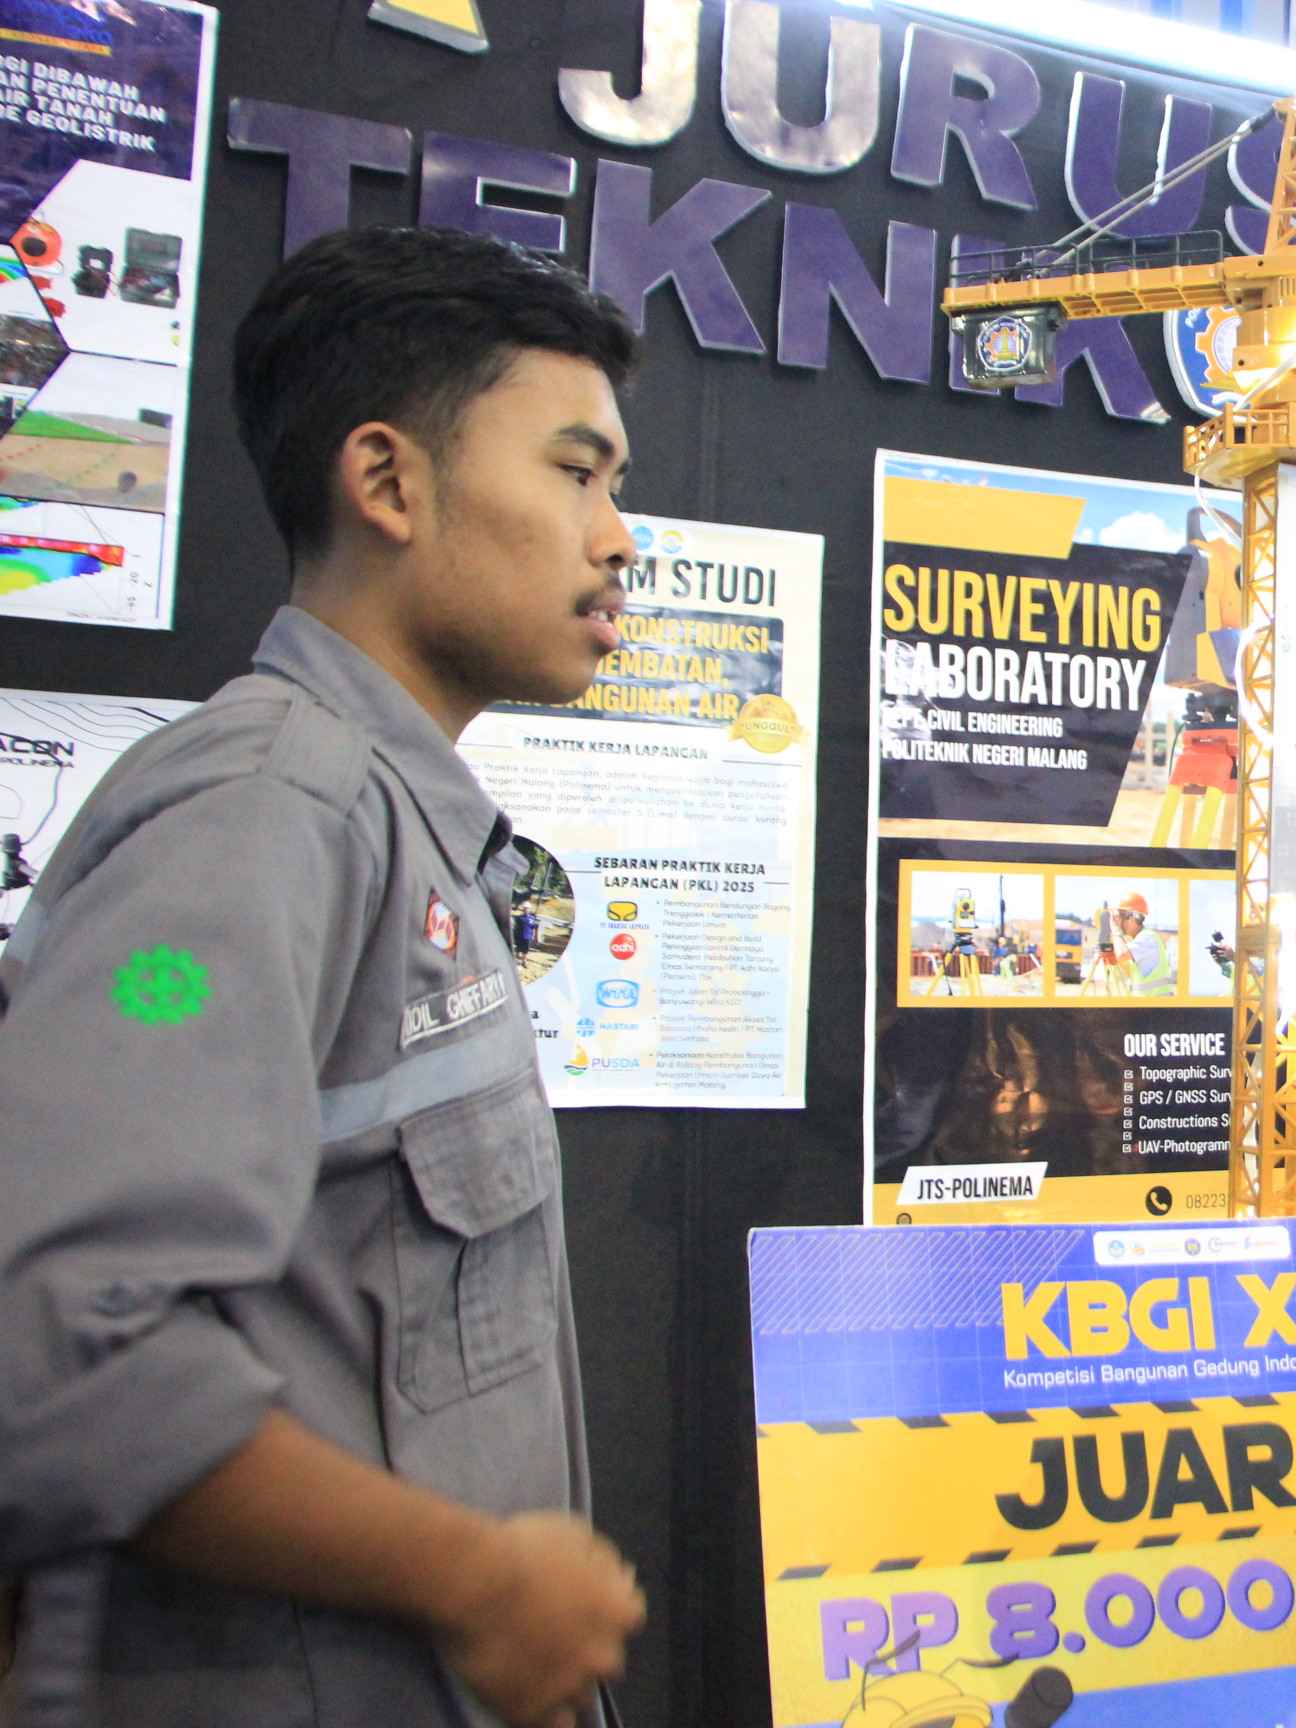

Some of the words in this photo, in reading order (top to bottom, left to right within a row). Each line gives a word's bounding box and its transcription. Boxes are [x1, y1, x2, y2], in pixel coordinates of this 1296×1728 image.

[34, 62, 140, 101] DIBAWAH
[32, 78, 167, 124] PENENTUAN
[35, 94, 114, 127] TANAH
[26, 109, 155, 151] GEOLISTRIK
[671, 558, 776, 607] STUDI
[883, 563, 1162, 653] SURVEYING
[614, 614, 770, 654] KONSTRUKSI
[884, 638, 1147, 712] LABORATORY
[697, 692, 740, 719] AIR
[927, 709, 965, 732] CIVIL
[967, 712, 1063, 738] ENGINEERING
[523, 737, 585, 752] PRAKTIK
[589, 741, 631, 755] KERJA
[634, 744, 708, 760] LAPANGAN
[882, 738, 970, 764] POLITEKNIK
[972, 744, 1024, 766] NEGERI
[1027, 747, 1088, 770] MALANG
[484, 762, 519, 773] Praktik
[523, 765, 548, 776] Kerja
[714, 776, 734, 787] bagi
[737, 779, 788, 789] mahasiswa
[485, 776, 517, 788] Negeri
[520, 778, 555, 790] Malang
[755, 814, 787, 826] kurang
[594, 856, 658, 870] SEBARAN
[661, 859, 721, 873] PRAKTIK
[724, 862, 766, 875] KERJA
[603, 876, 679, 889] LAPANGAN
[683, 879, 719, 892] (PKL)
[722, 880, 755, 893] 2025
[611, 943, 634, 952] adhi
[599, 1023, 639, 1031] HASTARI
[1124, 1033, 1157, 1058] OUR
[1160, 1033, 1226, 1057] SERVICE
[592, 1058, 641, 1068] PUSDA
[1139, 1065, 1207, 1083] Topographic
[1209, 1065, 1232, 1079] Surv
[1139, 1091, 1164, 1105] GPS
[1165, 1090, 1172, 1105] /
[1174, 1090, 1207, 1104] GNSS
[1209, 1089, 1231, 1103] Surv
[1139, 1114, 1218, 1130] Constructions
[917, 1175, 1034, 1201] JTS-POLINEMA
[1186, 1194, 1227, 1209] 08223
[1000, 1273, 1215, 1361] KBGI
[1003, 1368, 1095, 1390] Kompetisi
[1101, 1363, 1188, 1385] Bangunan
[1194, 1357, 1260, 1378] Gedung
[818, 1588, 960, 1682] RP
